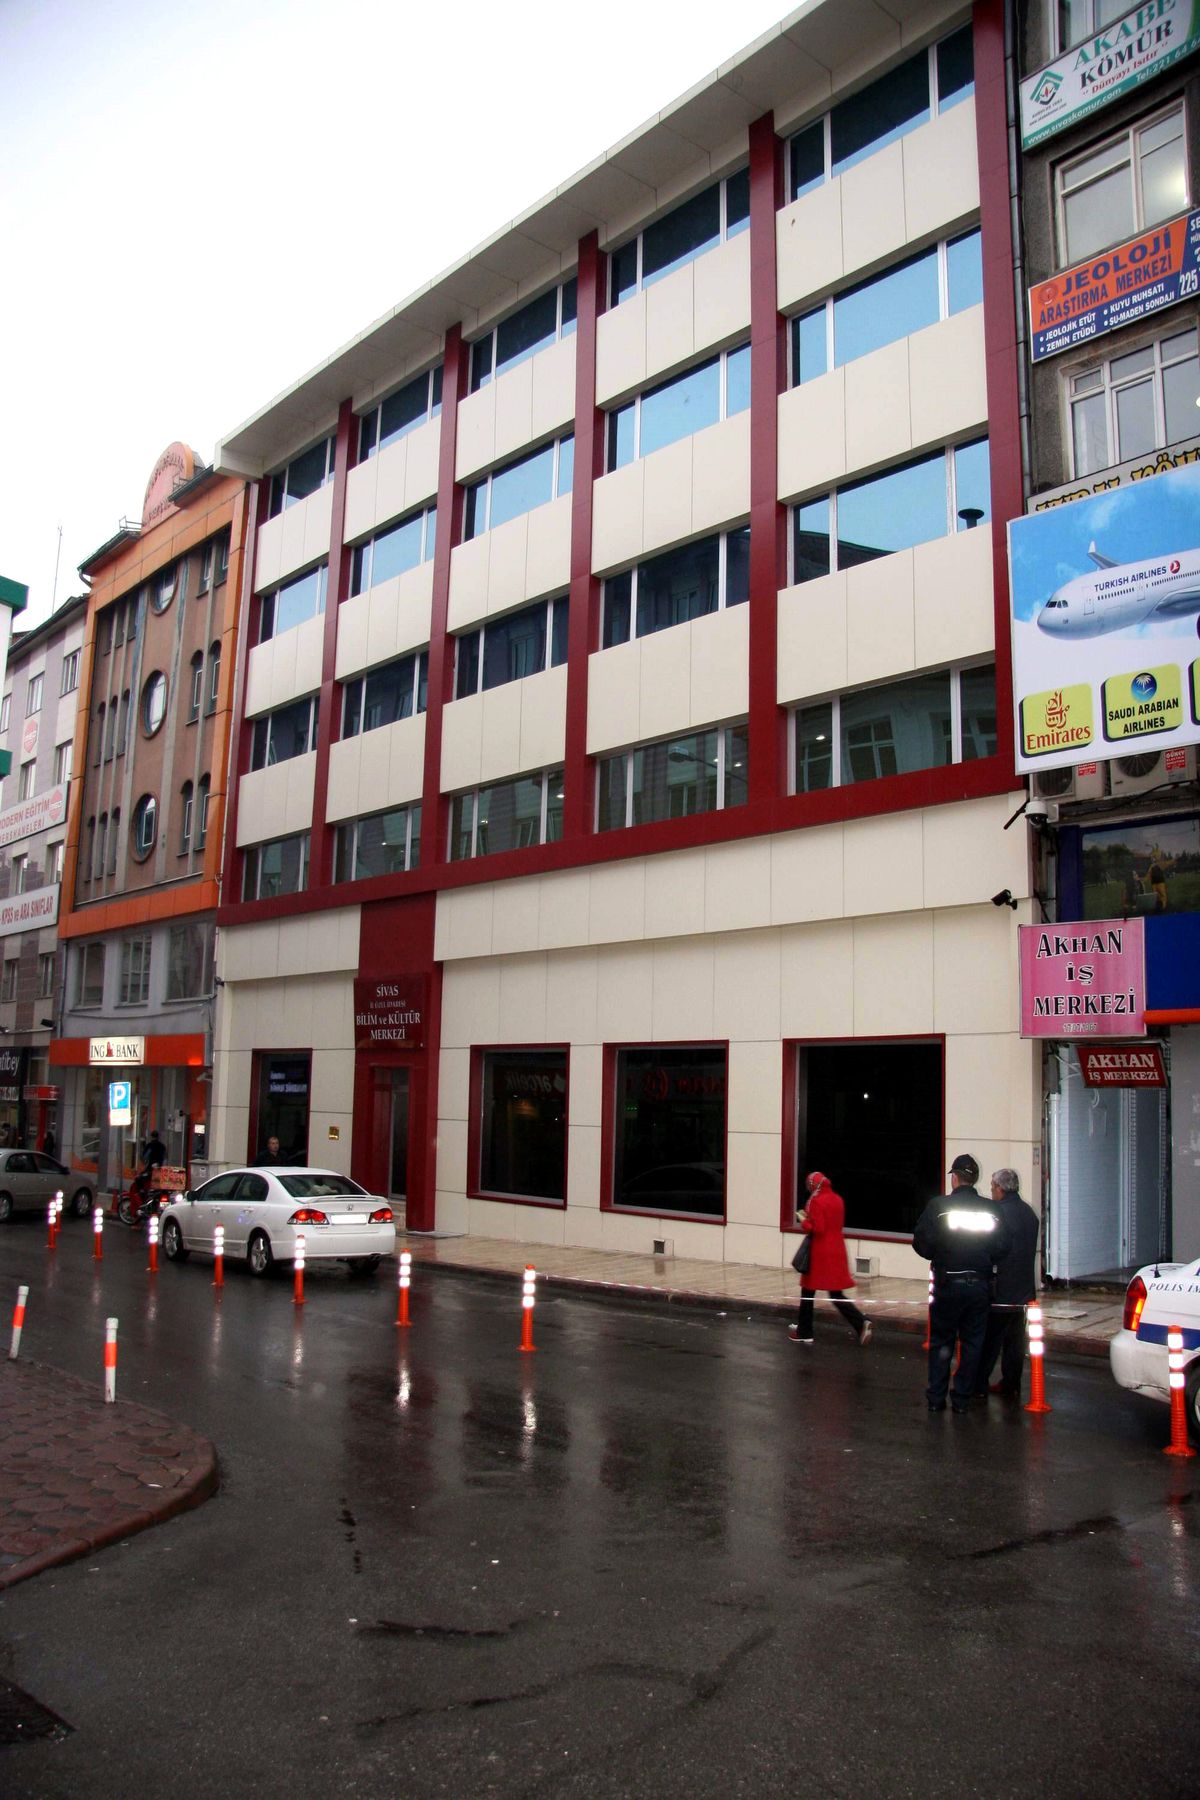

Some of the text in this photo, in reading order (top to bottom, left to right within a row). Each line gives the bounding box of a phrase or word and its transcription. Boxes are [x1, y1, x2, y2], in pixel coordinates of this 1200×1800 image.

[1080, 19, 1173, 89] KÖMÜR
[1028, 87, 1122, 145] www.sivaskomur.com
[1062, 227, 1172, 296] JEOLOJİ
[1039, 250, 1172, 327] ARAŞTIRMA MERKEZİ
[1179, 269, 1197, 296] 225
[1109, 290, 1175, 327] SU-MADEN SONDAJI
[1110, 283, 1164, 314] KUYU RUHSATI
[1045, 312, 1096, 342] JEOLOJİK ETÜT
[1046, 323, 1096, 353] ZEMİN ETÜDÜ
[1094, 566, 1167, 592] TURKISH AIRLINES
[1108, 697, 1179, 721] SAUDI ARABIAN
[1026, 725, 1091, 750] Emirates
[1123, 716, 1165, 735] AIRLINES
[1036, 929, 1123, 959] AKHAN
[376, 983, 399, 997] SİVAS
[1033, 987, 1136, 1017] MERKEZİ
[356, 1010, 421, 1026] BİLİM ve KÜLTÜR
[370, 1026, 406, 1040] MERKEZİ
[91, 1043, 138, 1058] ING BANK
[1087, 1053, 1155, 1068] AKHAN
[1103, 1069, 1160, 1081] MERKEZİ
[114, 1086, 125, 1108] P
